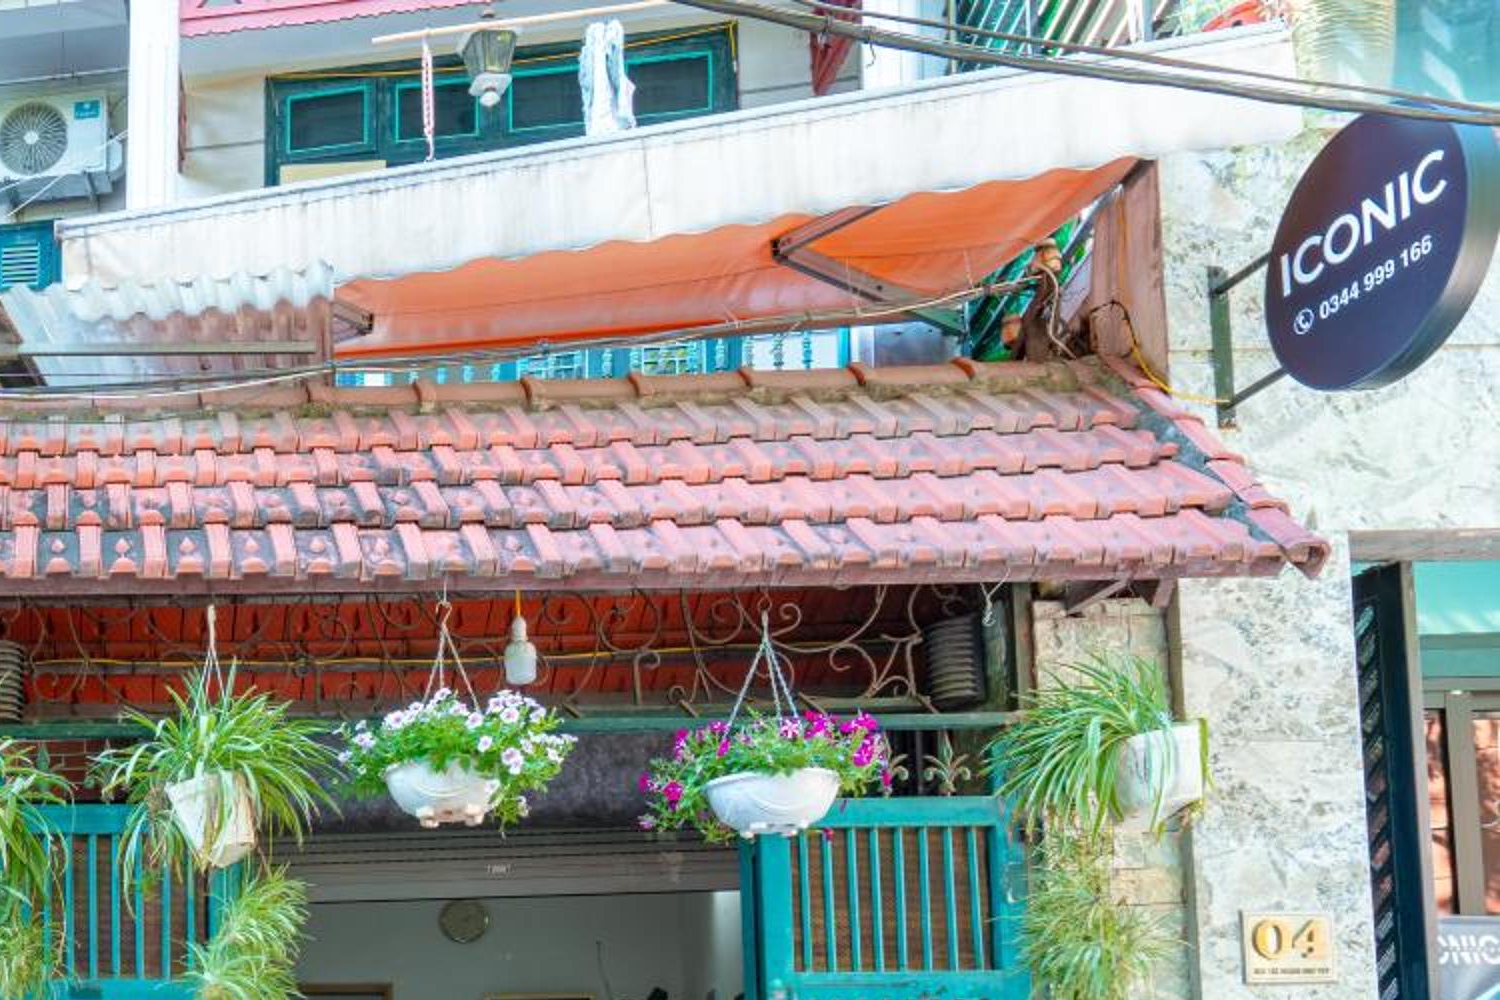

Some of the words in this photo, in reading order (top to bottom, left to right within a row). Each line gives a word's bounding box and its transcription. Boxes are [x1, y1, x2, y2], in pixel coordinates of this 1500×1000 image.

[1280, 149, 1448, 297] ICONIC
[1318, 281, 1360, 319] 0344
[1363, 258, 1396, 292] 999
[1399, 234, 1433, 268] 166
[1251, 918, 1323, 961] 04
